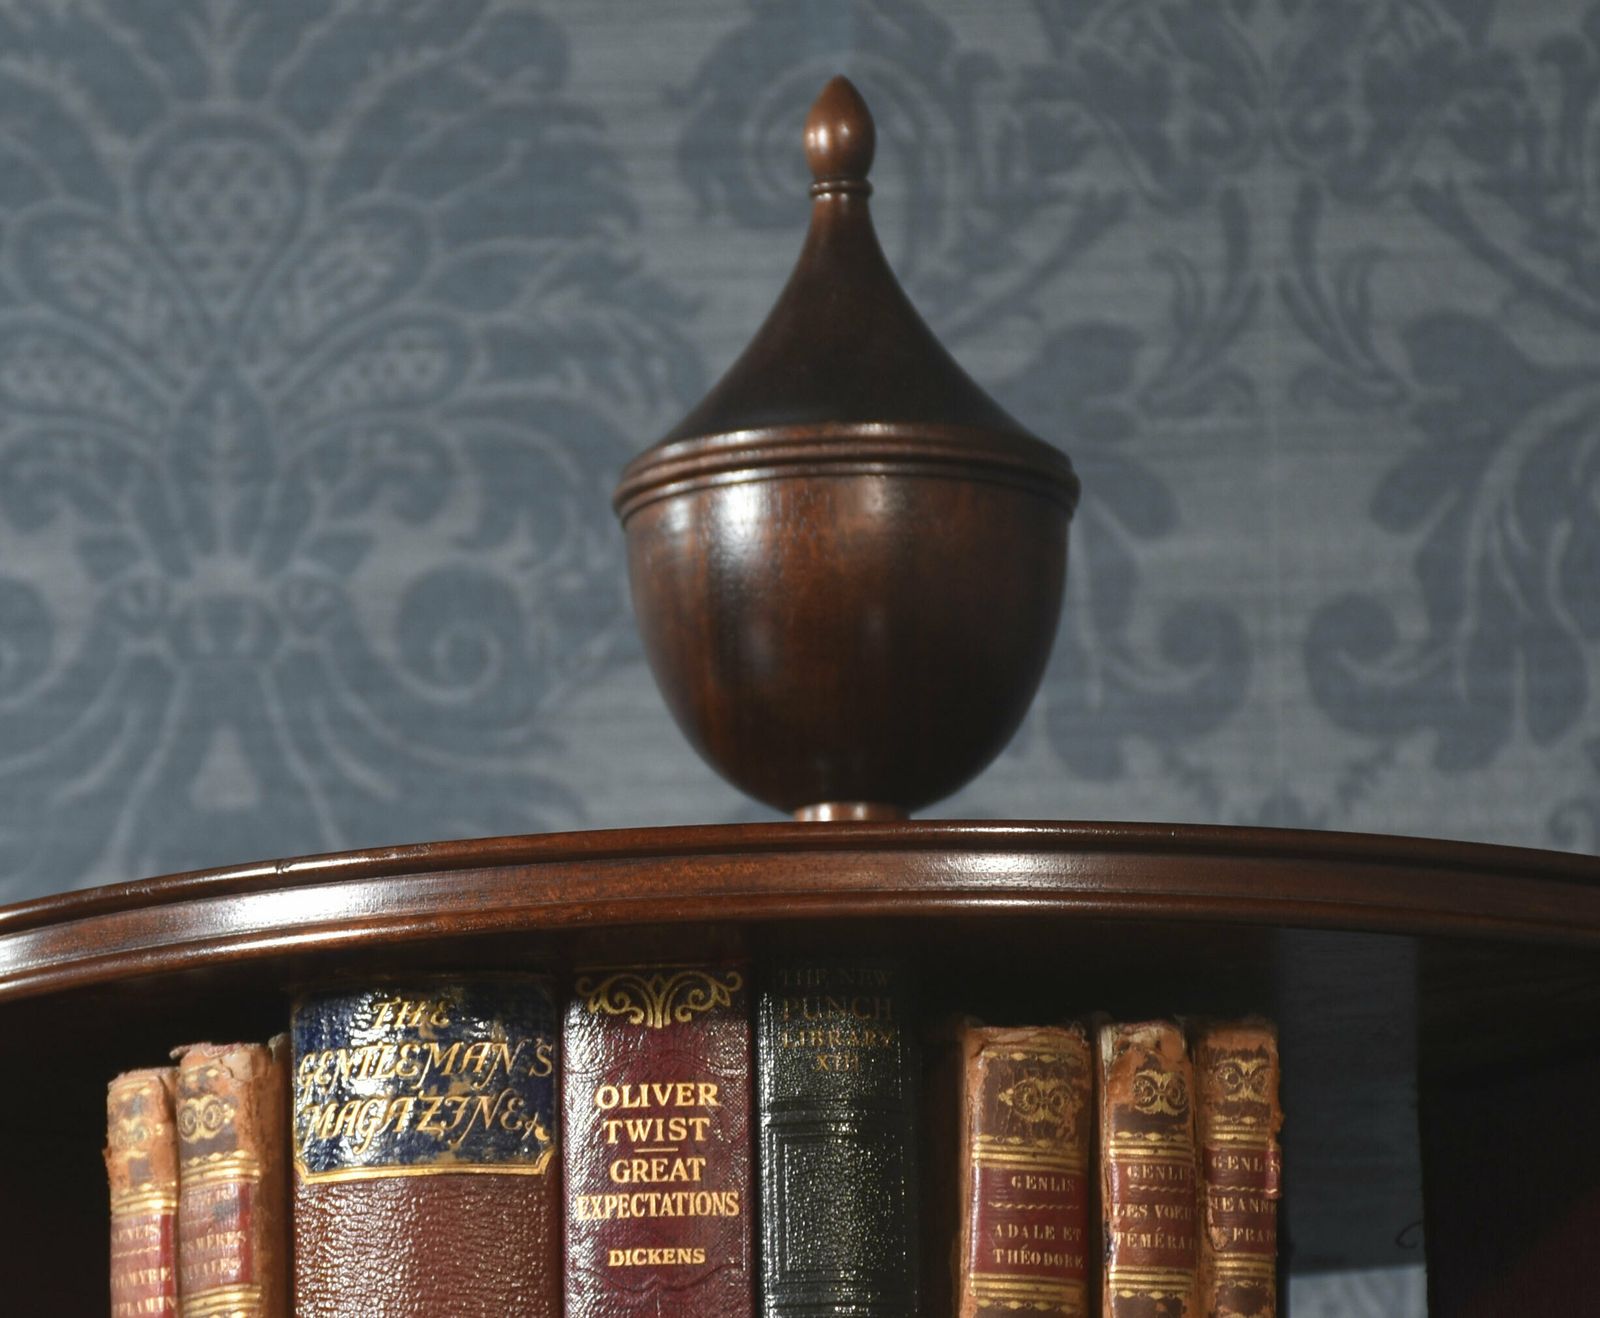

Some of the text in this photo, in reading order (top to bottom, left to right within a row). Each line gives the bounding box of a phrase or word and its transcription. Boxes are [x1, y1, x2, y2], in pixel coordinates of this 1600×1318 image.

[371, 999, 450, 1030] THE
[782, 997, 892, 1021] PUNCH
[781, 1028, 892, 1049] LIBRARY
[298, 1037, 553, 1096] GENTLEMAN'S
[594, 1083, 721, 1110] OLIVER
[602, 1117, 711, 1144] TWIST
[609, 1157, 706, 1184] GREAT
[575, 1191, 741, 1221] EXPECTATIONS
[1113, 1203, 1148, 1219] LES
[994, 1223, 1056, 1240] ADALE
[607, 1248, 706, 1267] DICKENS
